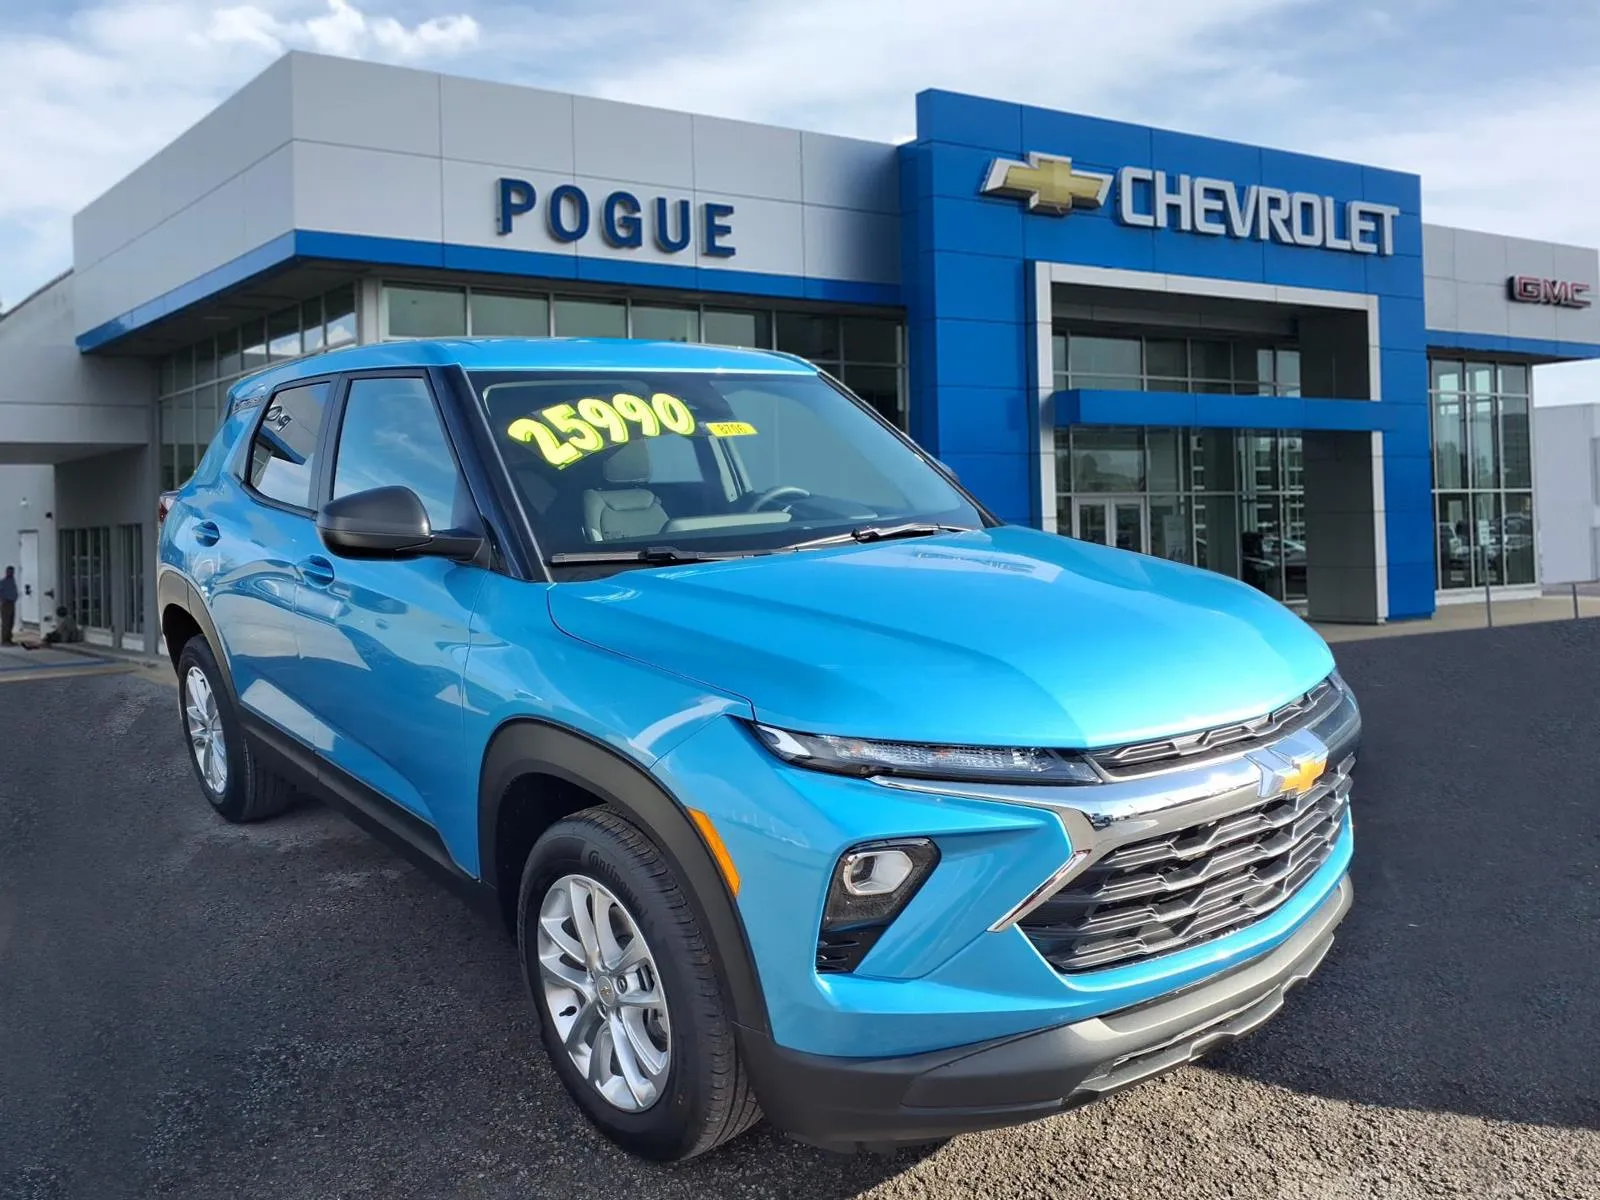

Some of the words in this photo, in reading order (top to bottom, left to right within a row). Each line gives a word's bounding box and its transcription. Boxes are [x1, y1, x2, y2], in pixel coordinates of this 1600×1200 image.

[496, 177, 736, 257] POGUE
[1118, 166, 1400, 256] CHEVROLET
[1514, 275, 1591, 308] GMC
[507, 393, 695, 469] 25990
